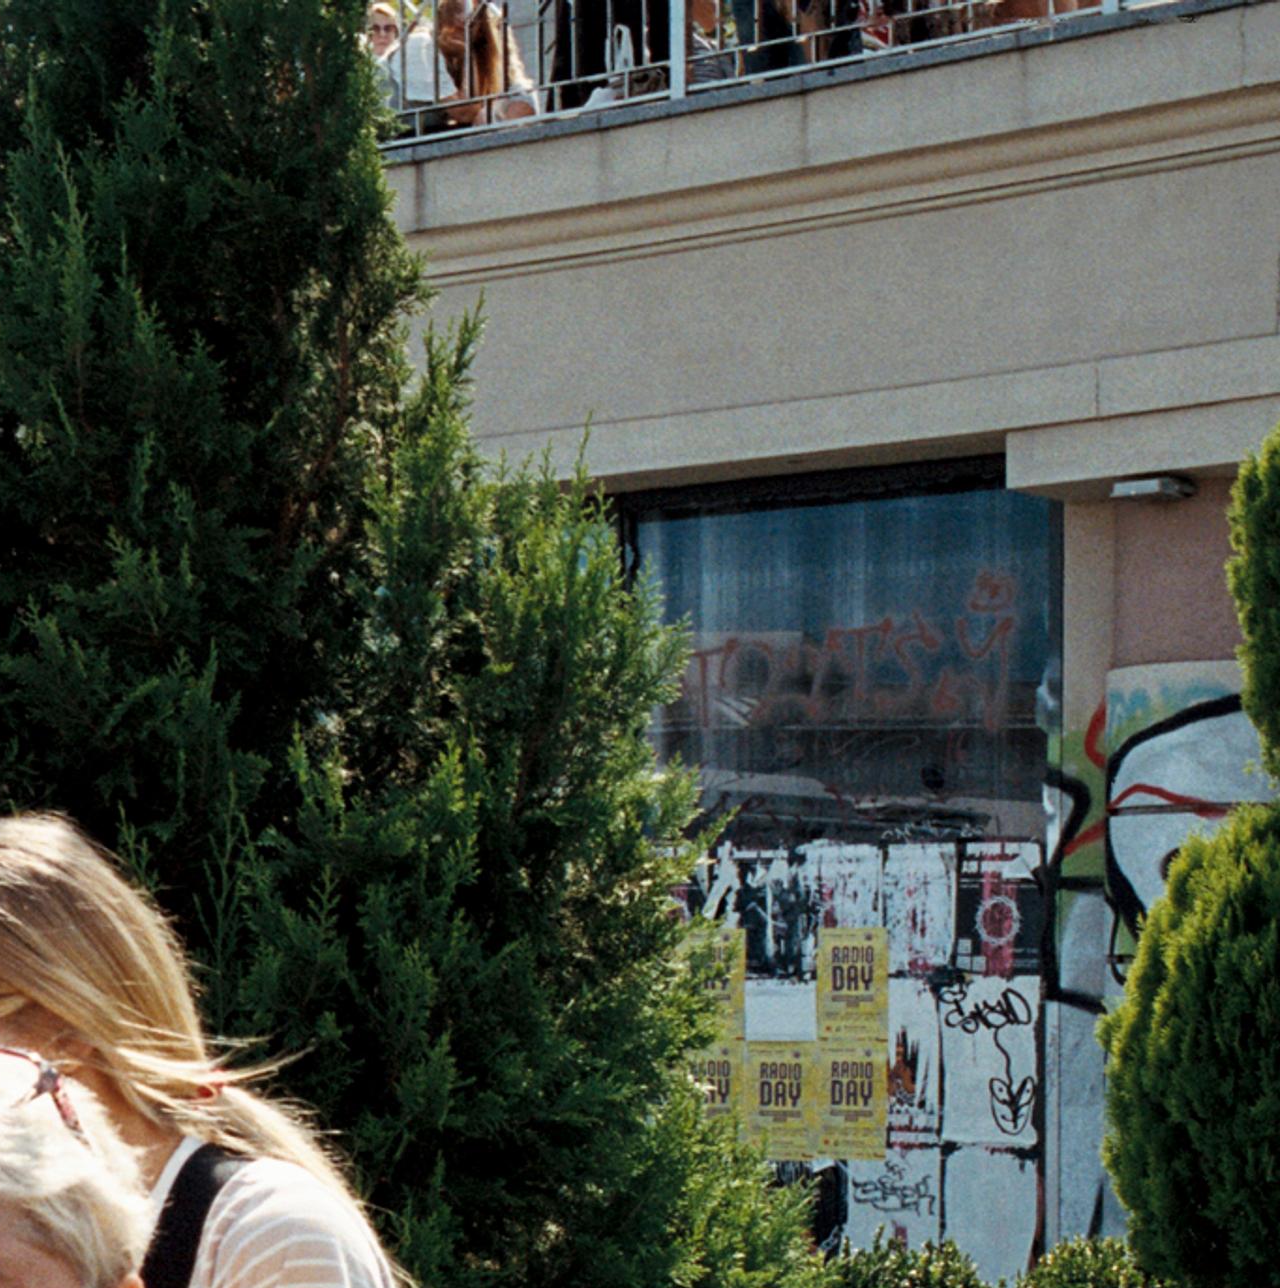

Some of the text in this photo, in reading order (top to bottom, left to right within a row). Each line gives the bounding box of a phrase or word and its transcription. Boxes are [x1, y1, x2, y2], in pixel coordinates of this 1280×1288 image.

[831, 945, 874, 964] RADIO
[831, 965, 874, 991] DAY
[759, 1062, 802, 1080] RADIO
[831, 1061, 874, 1079] RADIO
[758, 1081, 802, 1107] DAY
[830, 1080, 874, 1106] DAY
